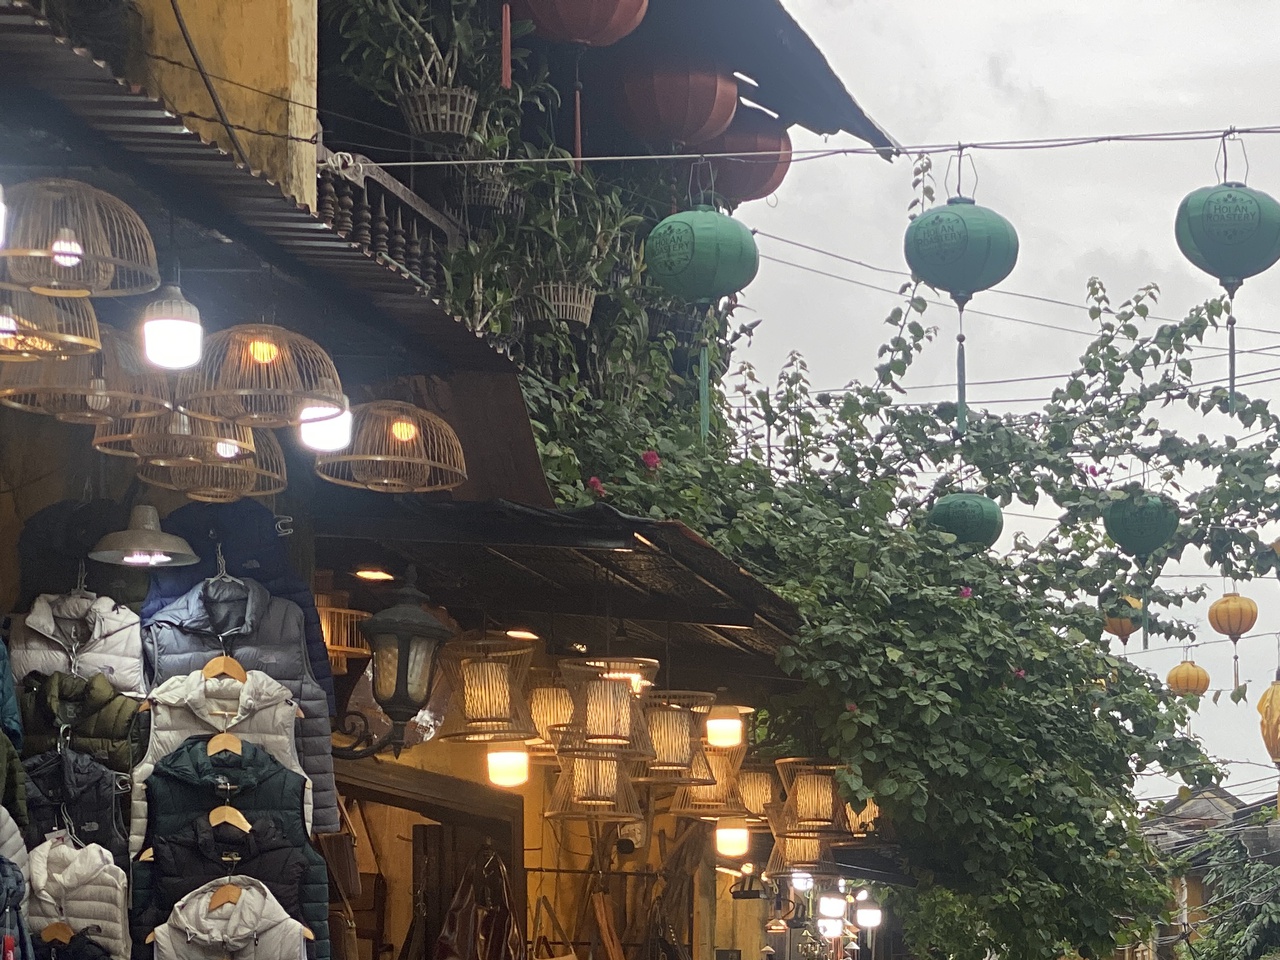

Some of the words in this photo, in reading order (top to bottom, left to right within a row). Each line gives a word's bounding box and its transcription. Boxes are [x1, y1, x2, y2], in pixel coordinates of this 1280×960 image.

[1234, 204, 1248, 213] AN
[1206, 212, 1256, 222] ROASTERY
[940, 225, 954, 233] AN
